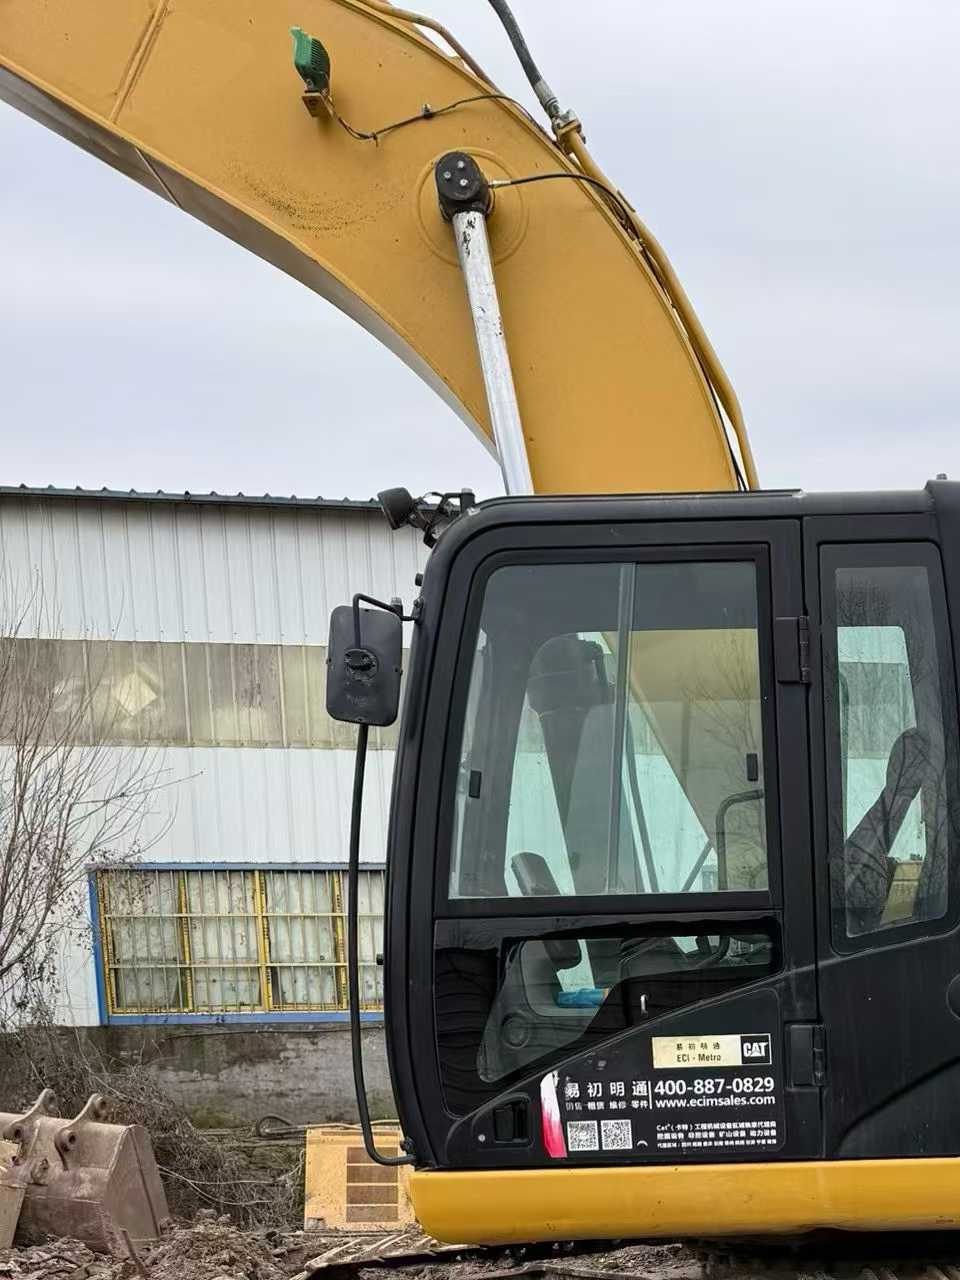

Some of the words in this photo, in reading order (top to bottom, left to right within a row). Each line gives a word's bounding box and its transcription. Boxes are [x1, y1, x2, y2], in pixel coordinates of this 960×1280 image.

[743, 1042, 768, 1057] CAT
[698, 1053, 721, 1062] Metro
[565, 1080, 648, 1099] 易初明通
[654, 1077, 775, 1096] 400-887-0829
[655, 1094, 776, 1108] www.ecimsales.com
